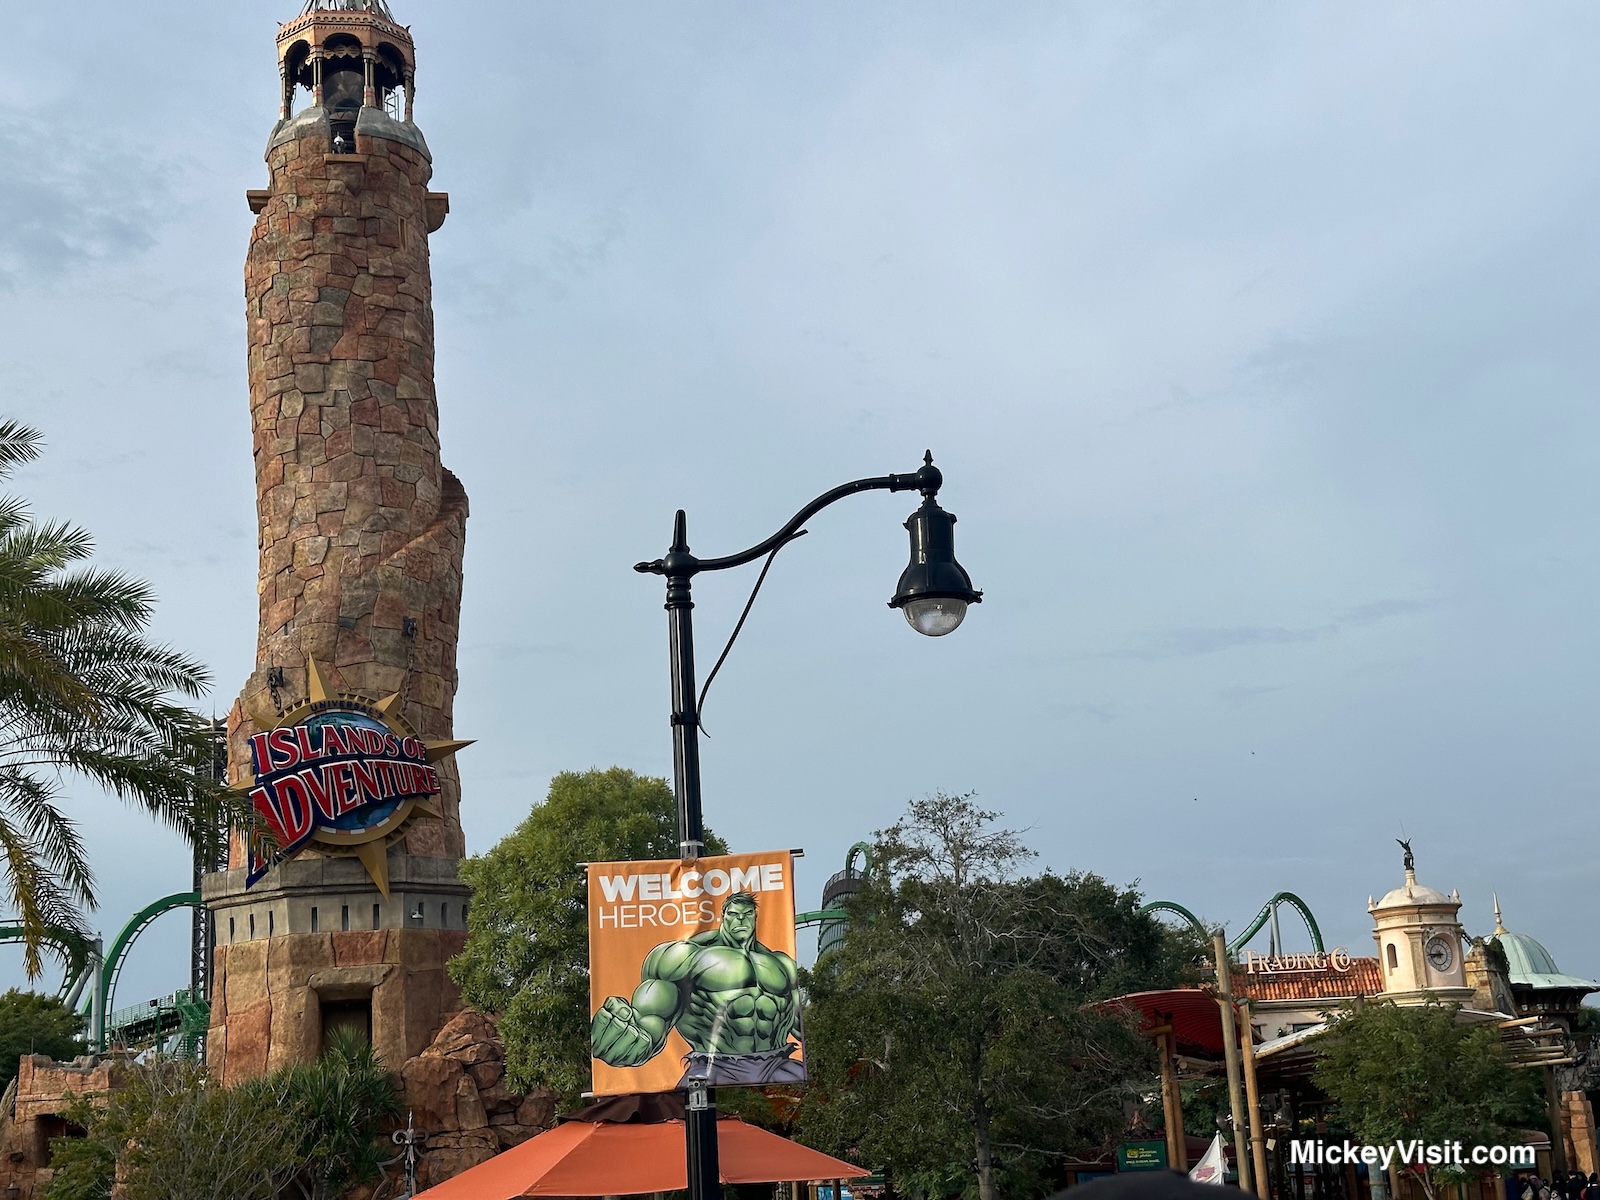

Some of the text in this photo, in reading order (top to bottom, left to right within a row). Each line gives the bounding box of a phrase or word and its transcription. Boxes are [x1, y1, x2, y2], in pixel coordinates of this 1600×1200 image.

[310, 700, 384, 719] UNIVERSAL'S
[252, 725, 427, 777] ISLANDS OF
[249, 759, 441, 874] ADVENTURE
[599, 863, 784, 902] WELCOME
[599, 900, 721, 929] HEROES.
